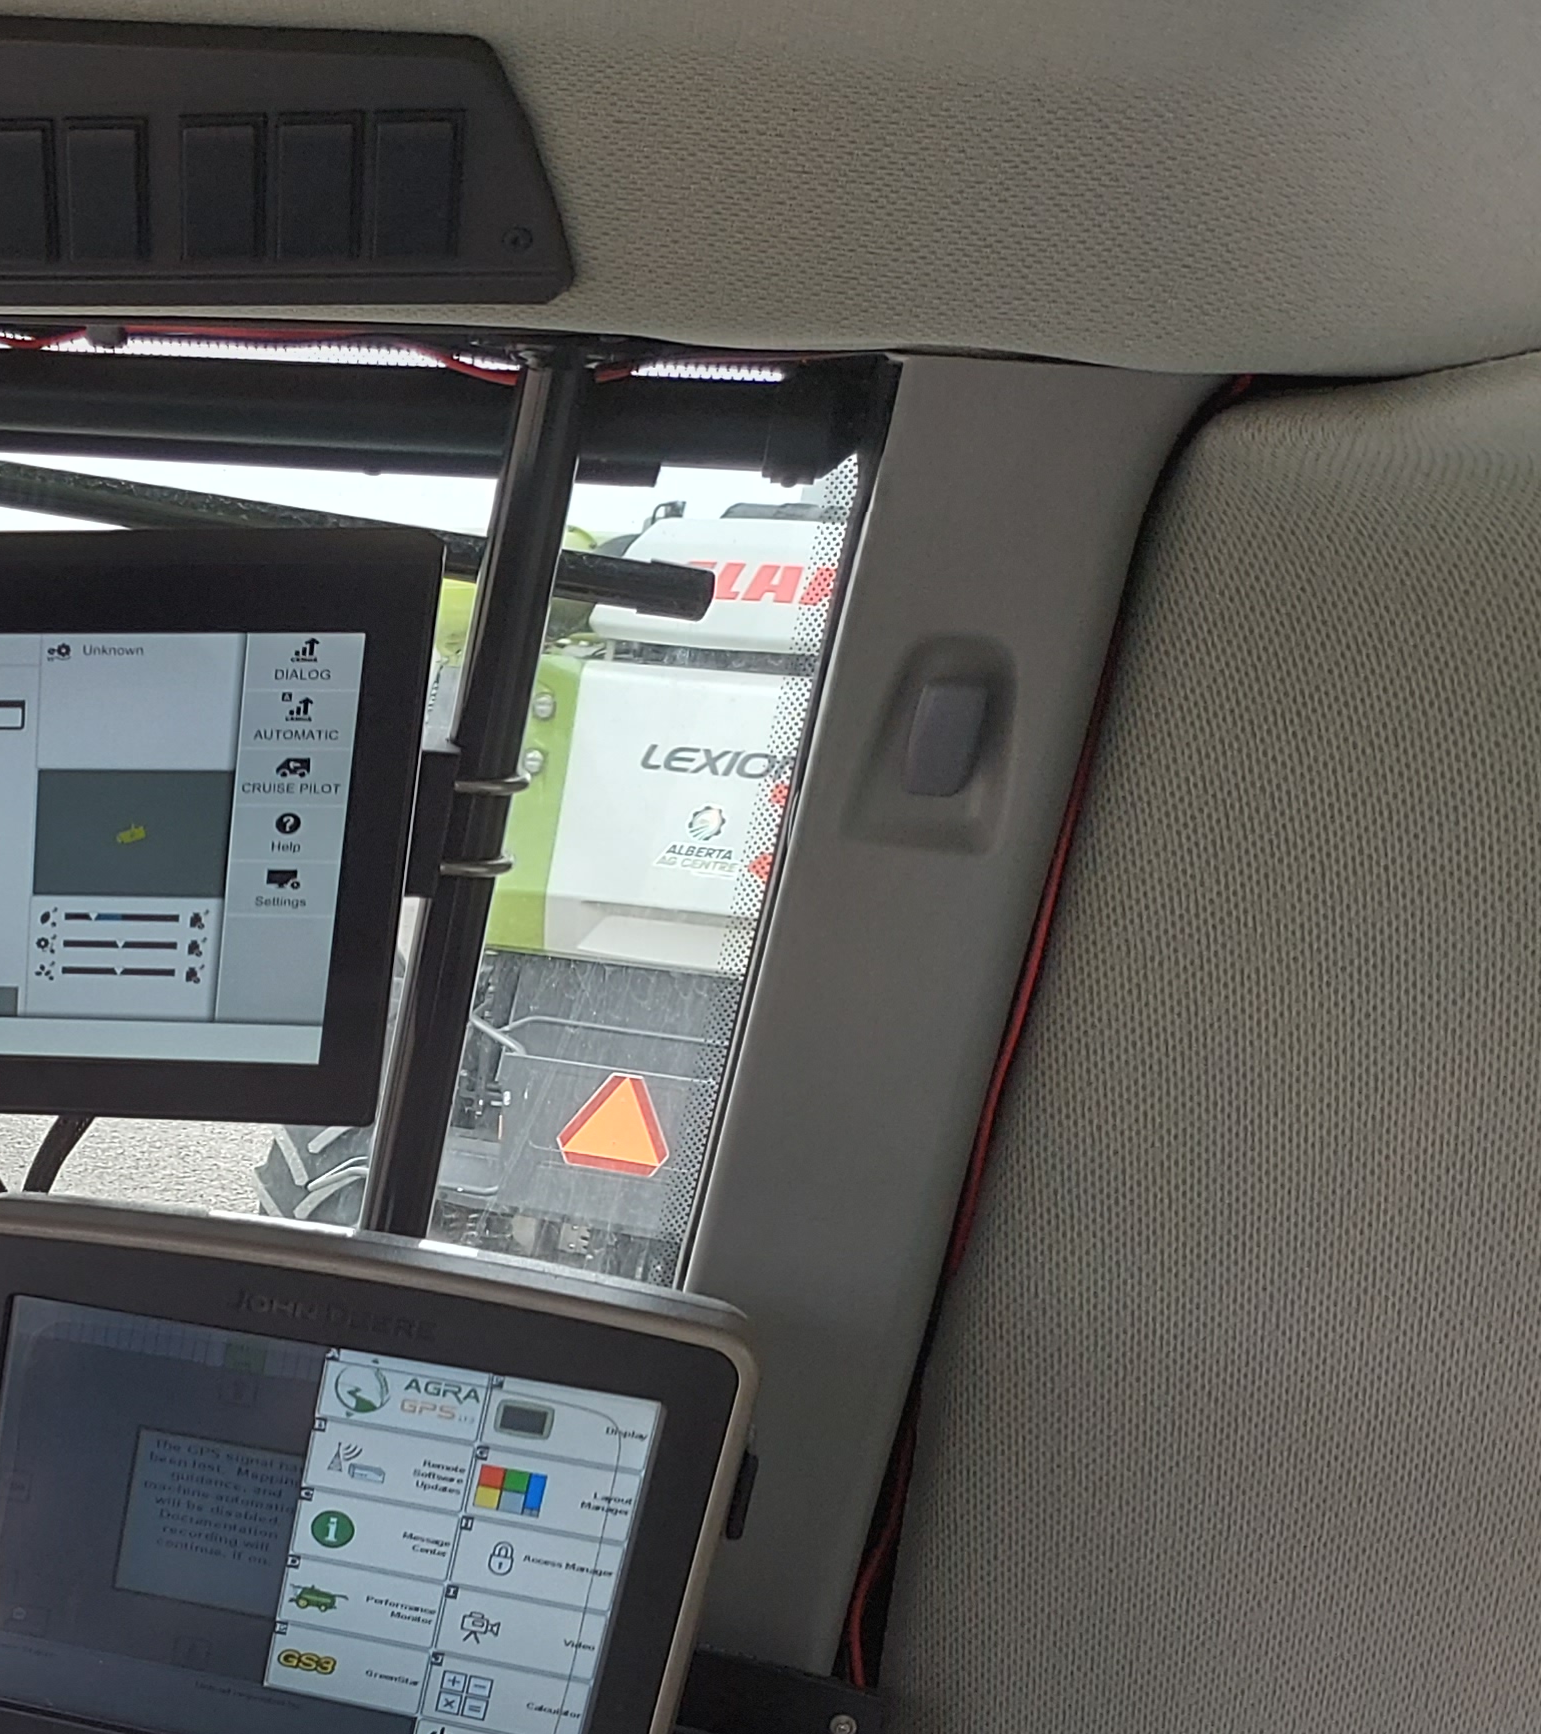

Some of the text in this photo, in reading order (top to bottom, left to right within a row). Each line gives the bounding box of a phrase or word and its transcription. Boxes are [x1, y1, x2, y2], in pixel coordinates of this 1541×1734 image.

[82, 644, 145, 657] Unknown
[274, 668, 332, 681] DIALOG
[253, 729, 339, 742] AUTOMATIC
[242, 782, 342, 795] CRUISE PILOT
[271, 840, 301, 853] Help
[665, 844, 734, 861] ALBERTA
[681, 859, 738, 874] CENTRE
[255, 896, 307, 909] Settings
[404, 1378, 480, 1405] AGRA
[400, 1398, 458, 1420] GPS
[604, 1426, 649, 1442] Display
[187, 1445, 220, 1459] GPS
[423, 1459, 466, 1474] Remote
[413, 1468, 464, 1485] Software
[415, 1480, 461, 1496] Updates
[593, 1491, 633, 1506] Layout
[580, 1500, 630, 1517] Manager
[403, 1531, 450, 1548] Message
[412, 1545, 447, 1558] Center
[523, 1555, 614, 1578] Access Manager
[366, 1595, 436, 1615] Performance
[390, 1610, 433, 1626] Monitor
[563, 1638, 596, 1652] Video
[278, 1649, 337, 1675] GS3
[365, 1669, 420, 1687] GreenStar
[526, 1702, 582, 1720] Calculator
